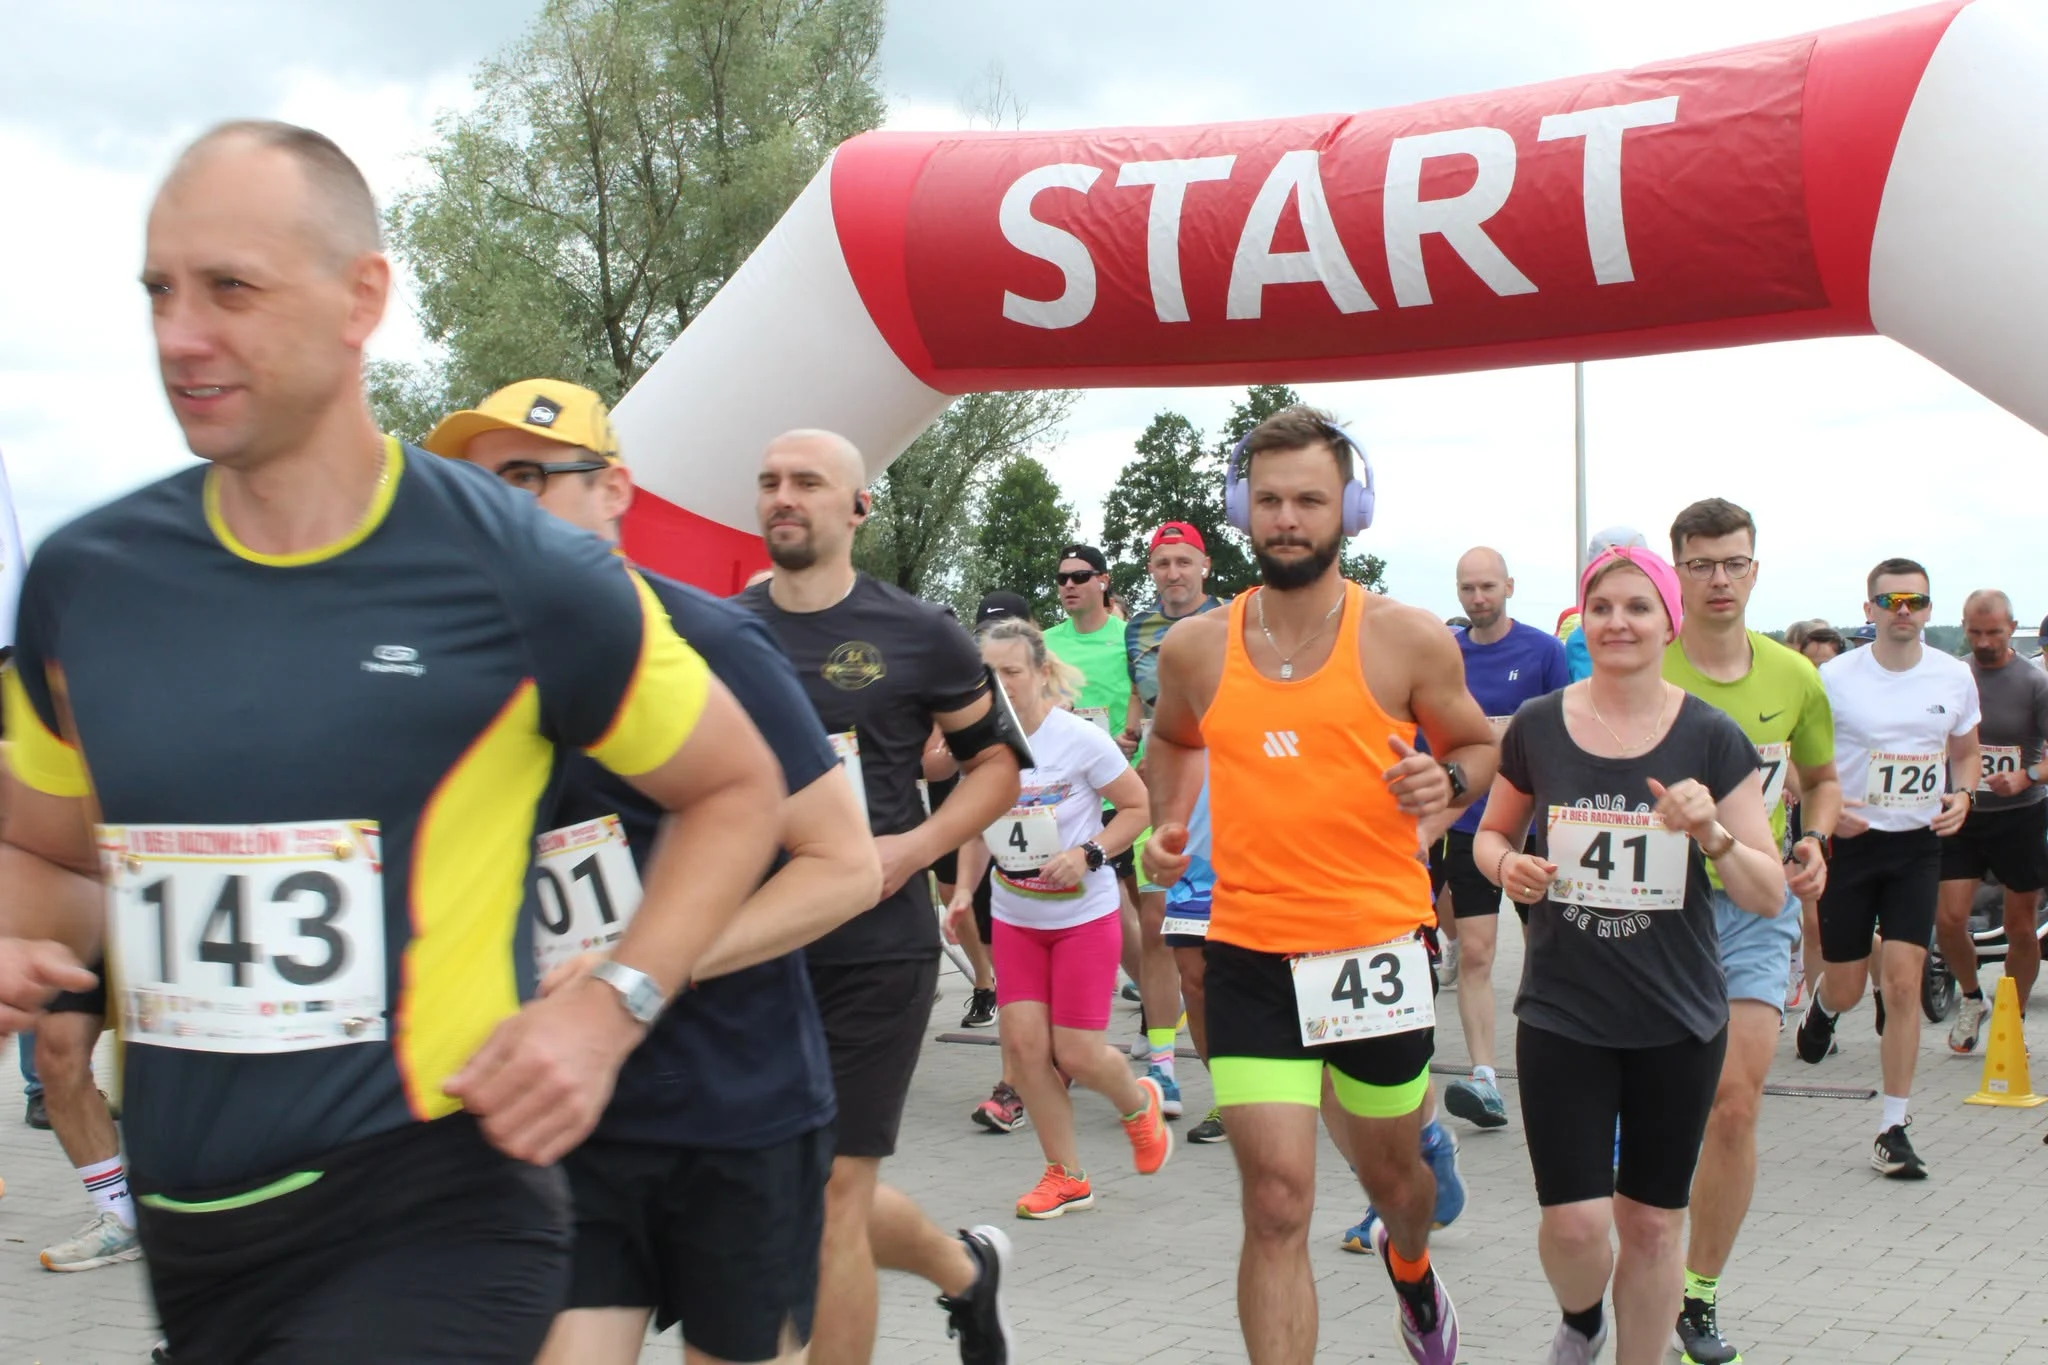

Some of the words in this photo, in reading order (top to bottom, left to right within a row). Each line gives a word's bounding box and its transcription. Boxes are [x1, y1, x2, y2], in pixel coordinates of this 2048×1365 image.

[999, 95, 1680, 330] START
[1878, 763, 1937, 795] 126
[1009, 821, 1029, 853] 4
[1569, 810, 1588, 822] BIEG
[1590, 811, 1650, 826] RADZIWIŁŁÓW
[1579, 831, 1648, 883] 41
[141, 870, 348, 988] 143
[1563, 904, 1591, 930] BE
[1597, 913, 1651, 938] KIND
[1331, 952, 1404, 1010] 43
